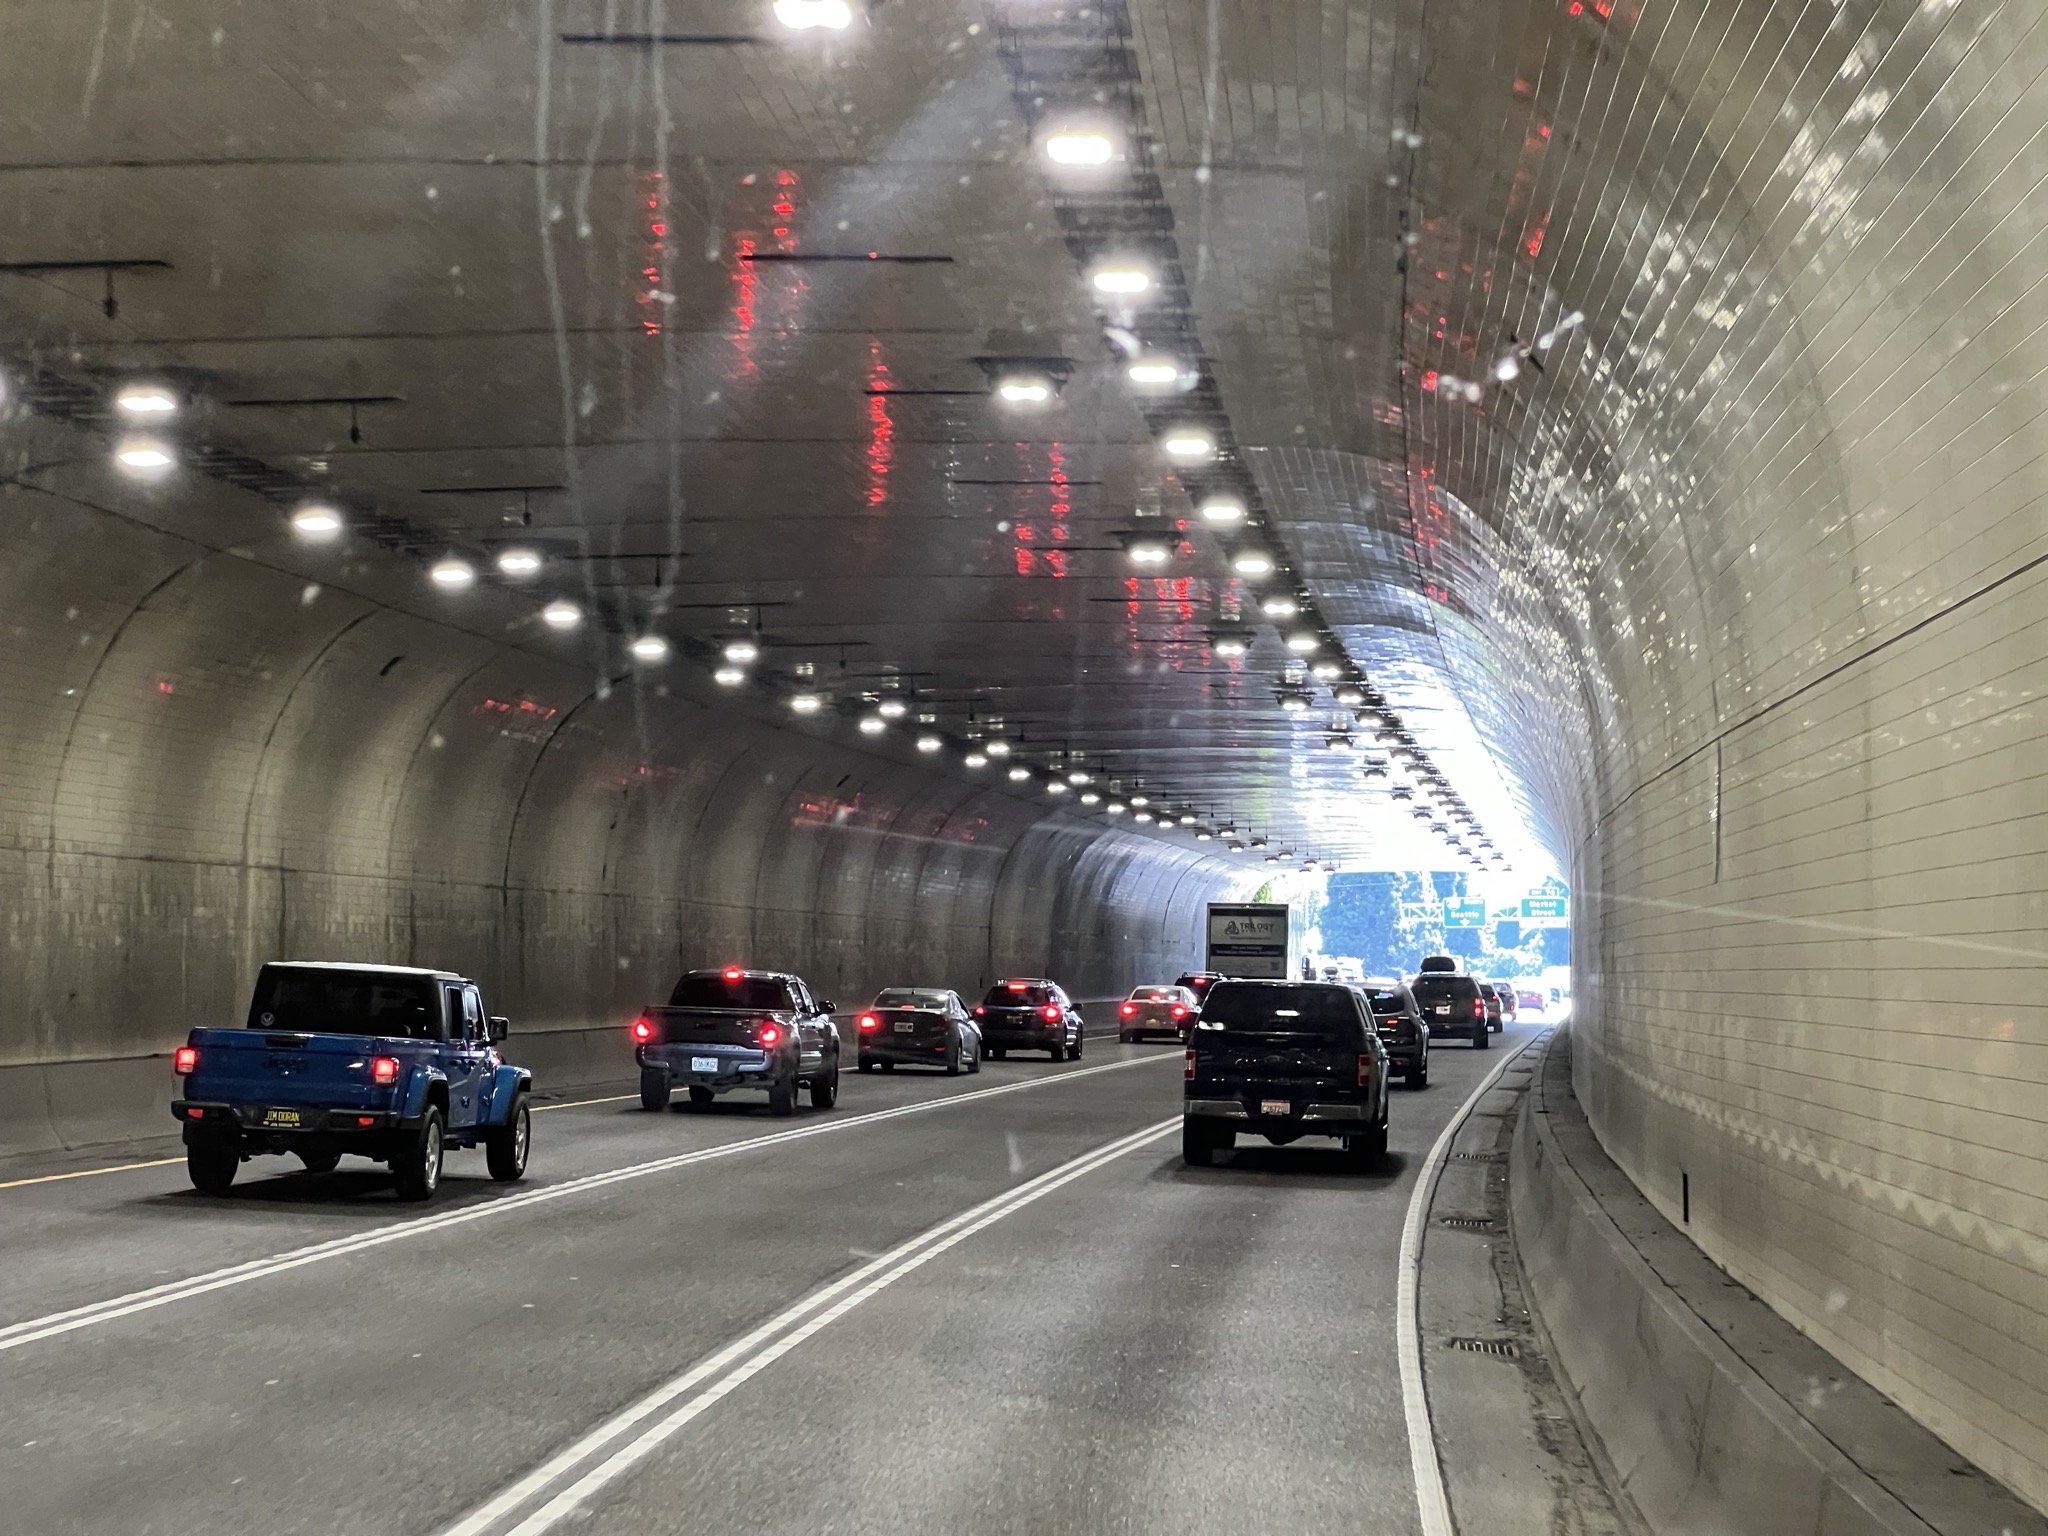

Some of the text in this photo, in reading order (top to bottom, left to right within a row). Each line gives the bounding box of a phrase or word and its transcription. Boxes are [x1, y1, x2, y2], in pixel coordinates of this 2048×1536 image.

[1529, 900, 1557, 908] Market
[1240, 922, 1274, 932] TRILOGY
[265, 1110, 278, 1121] JIM
